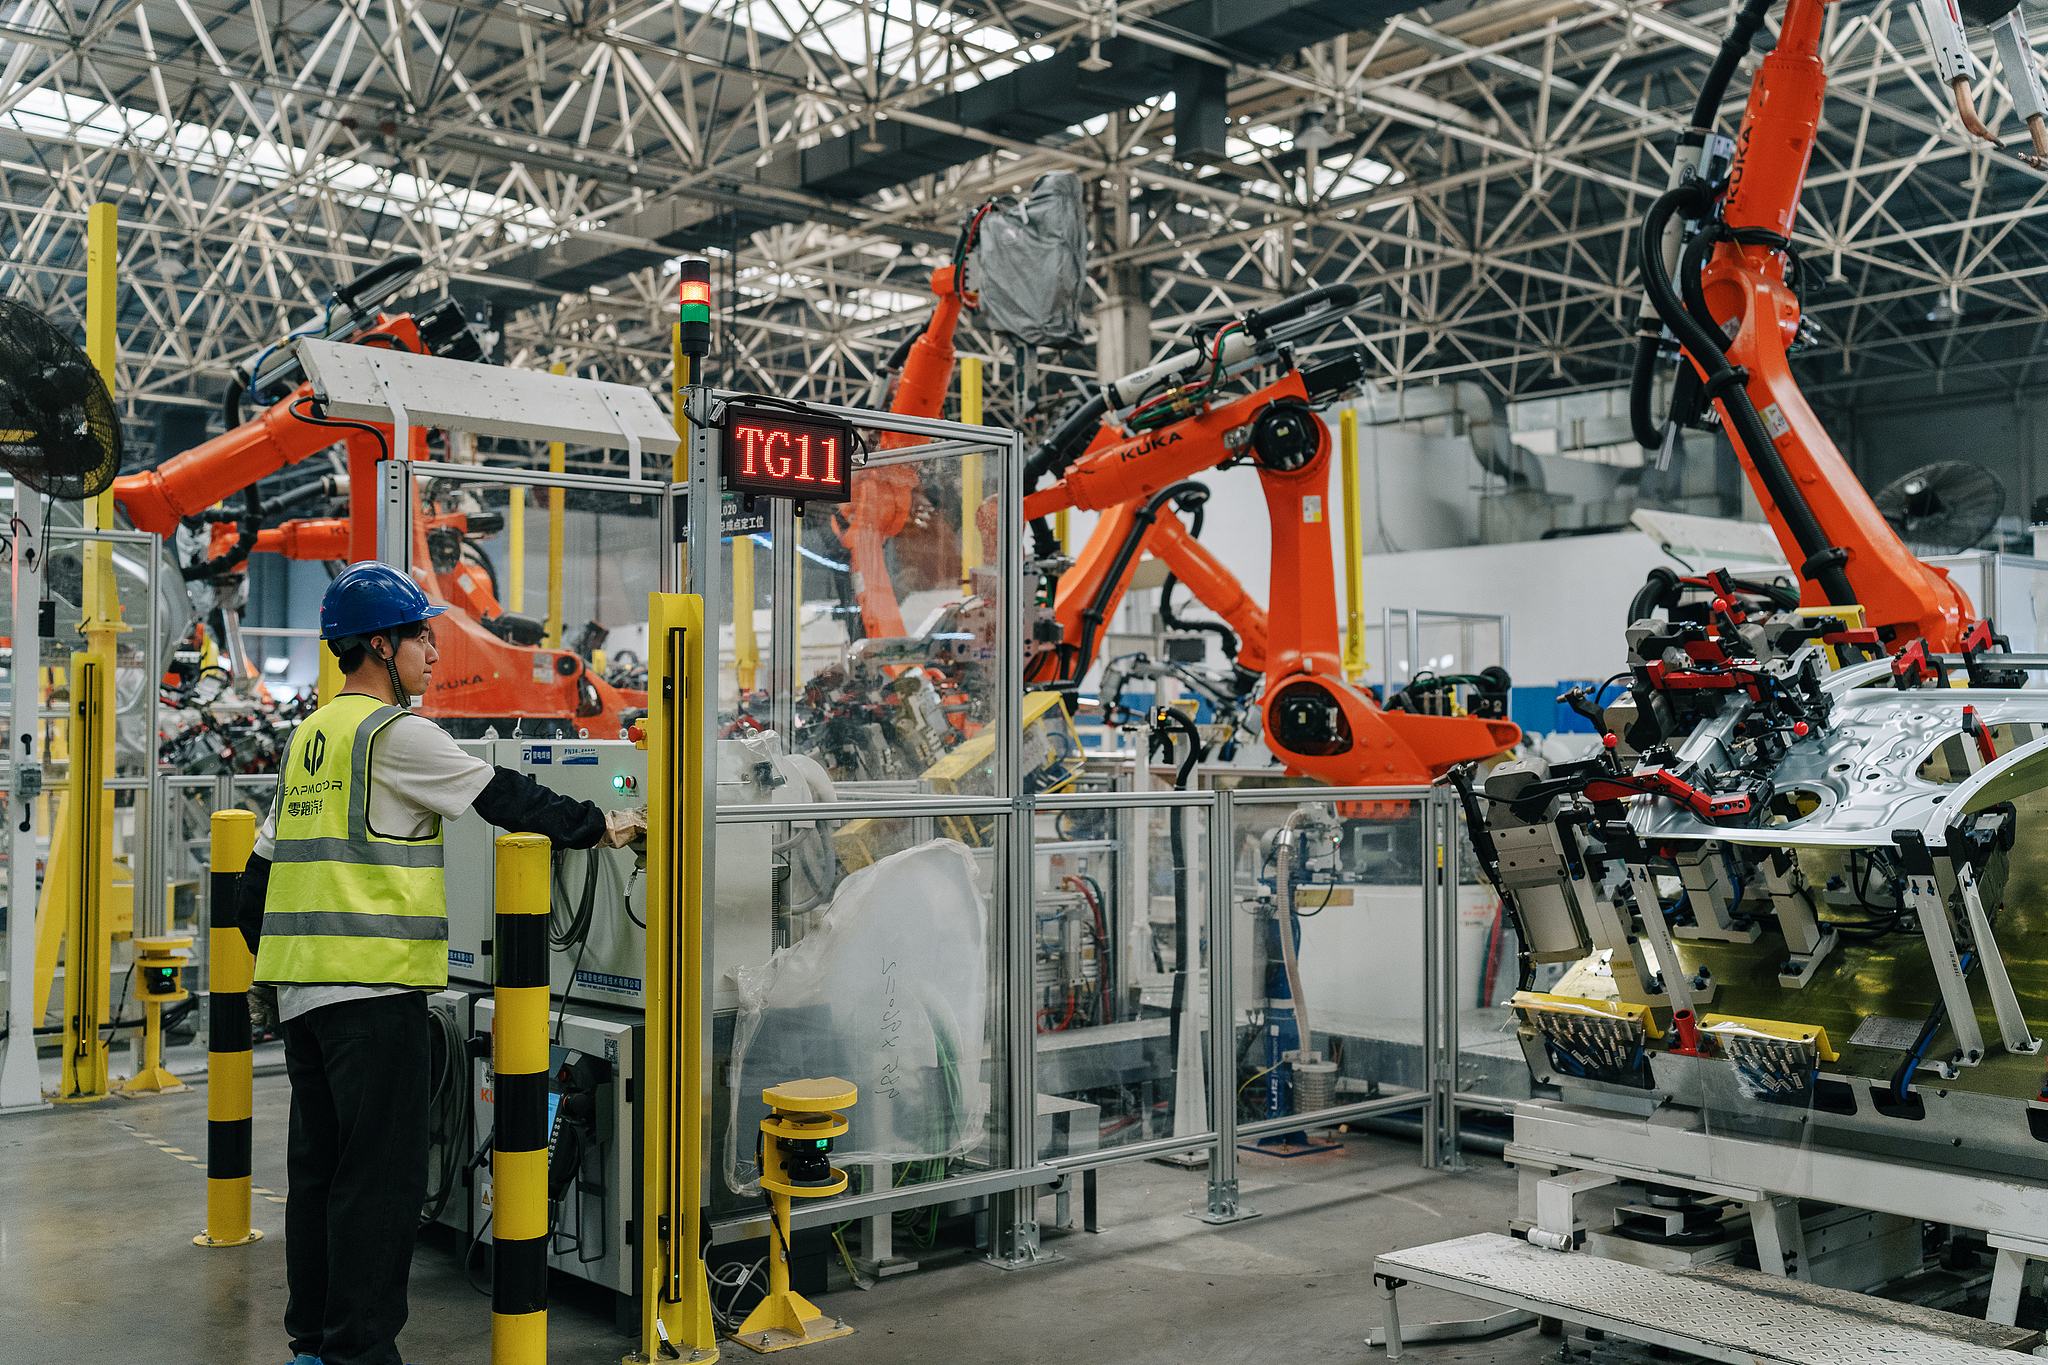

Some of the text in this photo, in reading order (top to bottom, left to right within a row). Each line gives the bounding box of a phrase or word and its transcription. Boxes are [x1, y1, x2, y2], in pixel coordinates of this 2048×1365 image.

[1727, 126, 1753, 204] KUKA
[735, 426, 842, 484] TG11
[1120, 432, 1183, 462] KUKA
[720, 504, 737, 516] 020
[435, 674, 483, 691] KUKA
